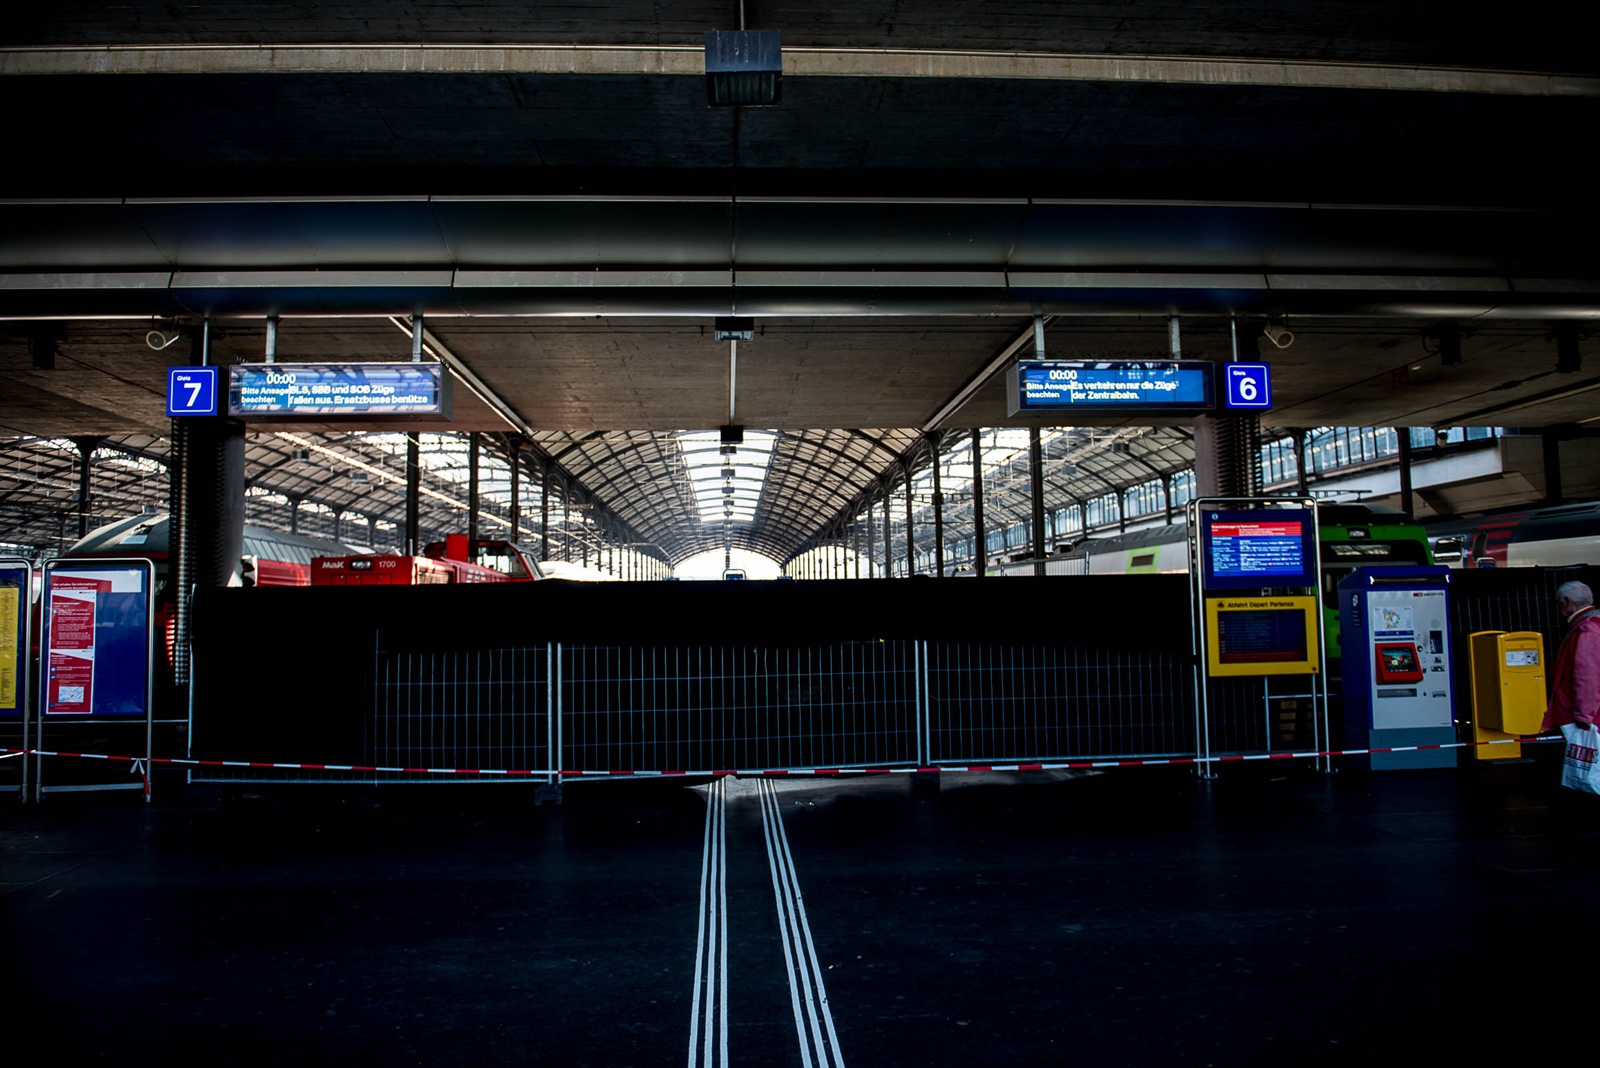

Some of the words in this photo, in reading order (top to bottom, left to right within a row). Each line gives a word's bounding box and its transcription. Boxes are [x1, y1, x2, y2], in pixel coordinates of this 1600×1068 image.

[266, 373, 297, 385] 00:00
[1049, 370, 1078, 381] 00:00
[241, 386, 260, 395] Bitte
[289, 385, 311, 396] BLS,
[311, 385, 331, 395] SBB
[331, 385, 349, 394] und
[349, 385, 371, 395] SOB
[371, 384, 395, 395] Züge
[1026, 382, 1044, 390] Bitte
[1072, 381, 1083, 390] Es
[1083, 381, 1127, 390] verkehren
[1127, 382, 1140, 390] nur
[1141, 381, 1154, 390] die
[1154, 380, 1177, 391] Züge
[1240, 377, 1257, 400] 6
[183, 382, 202, 407] 7
[289, 395, 314, 405] fallen
[314, 396, 334, 405] aus.
[334, 395, 391, 405] Ersatzbusse
[1072, 391, 1087, 400] der
[1087, 390, 1140, 400] Zentralbahn.
[378, 560, 396, 569] 1700
